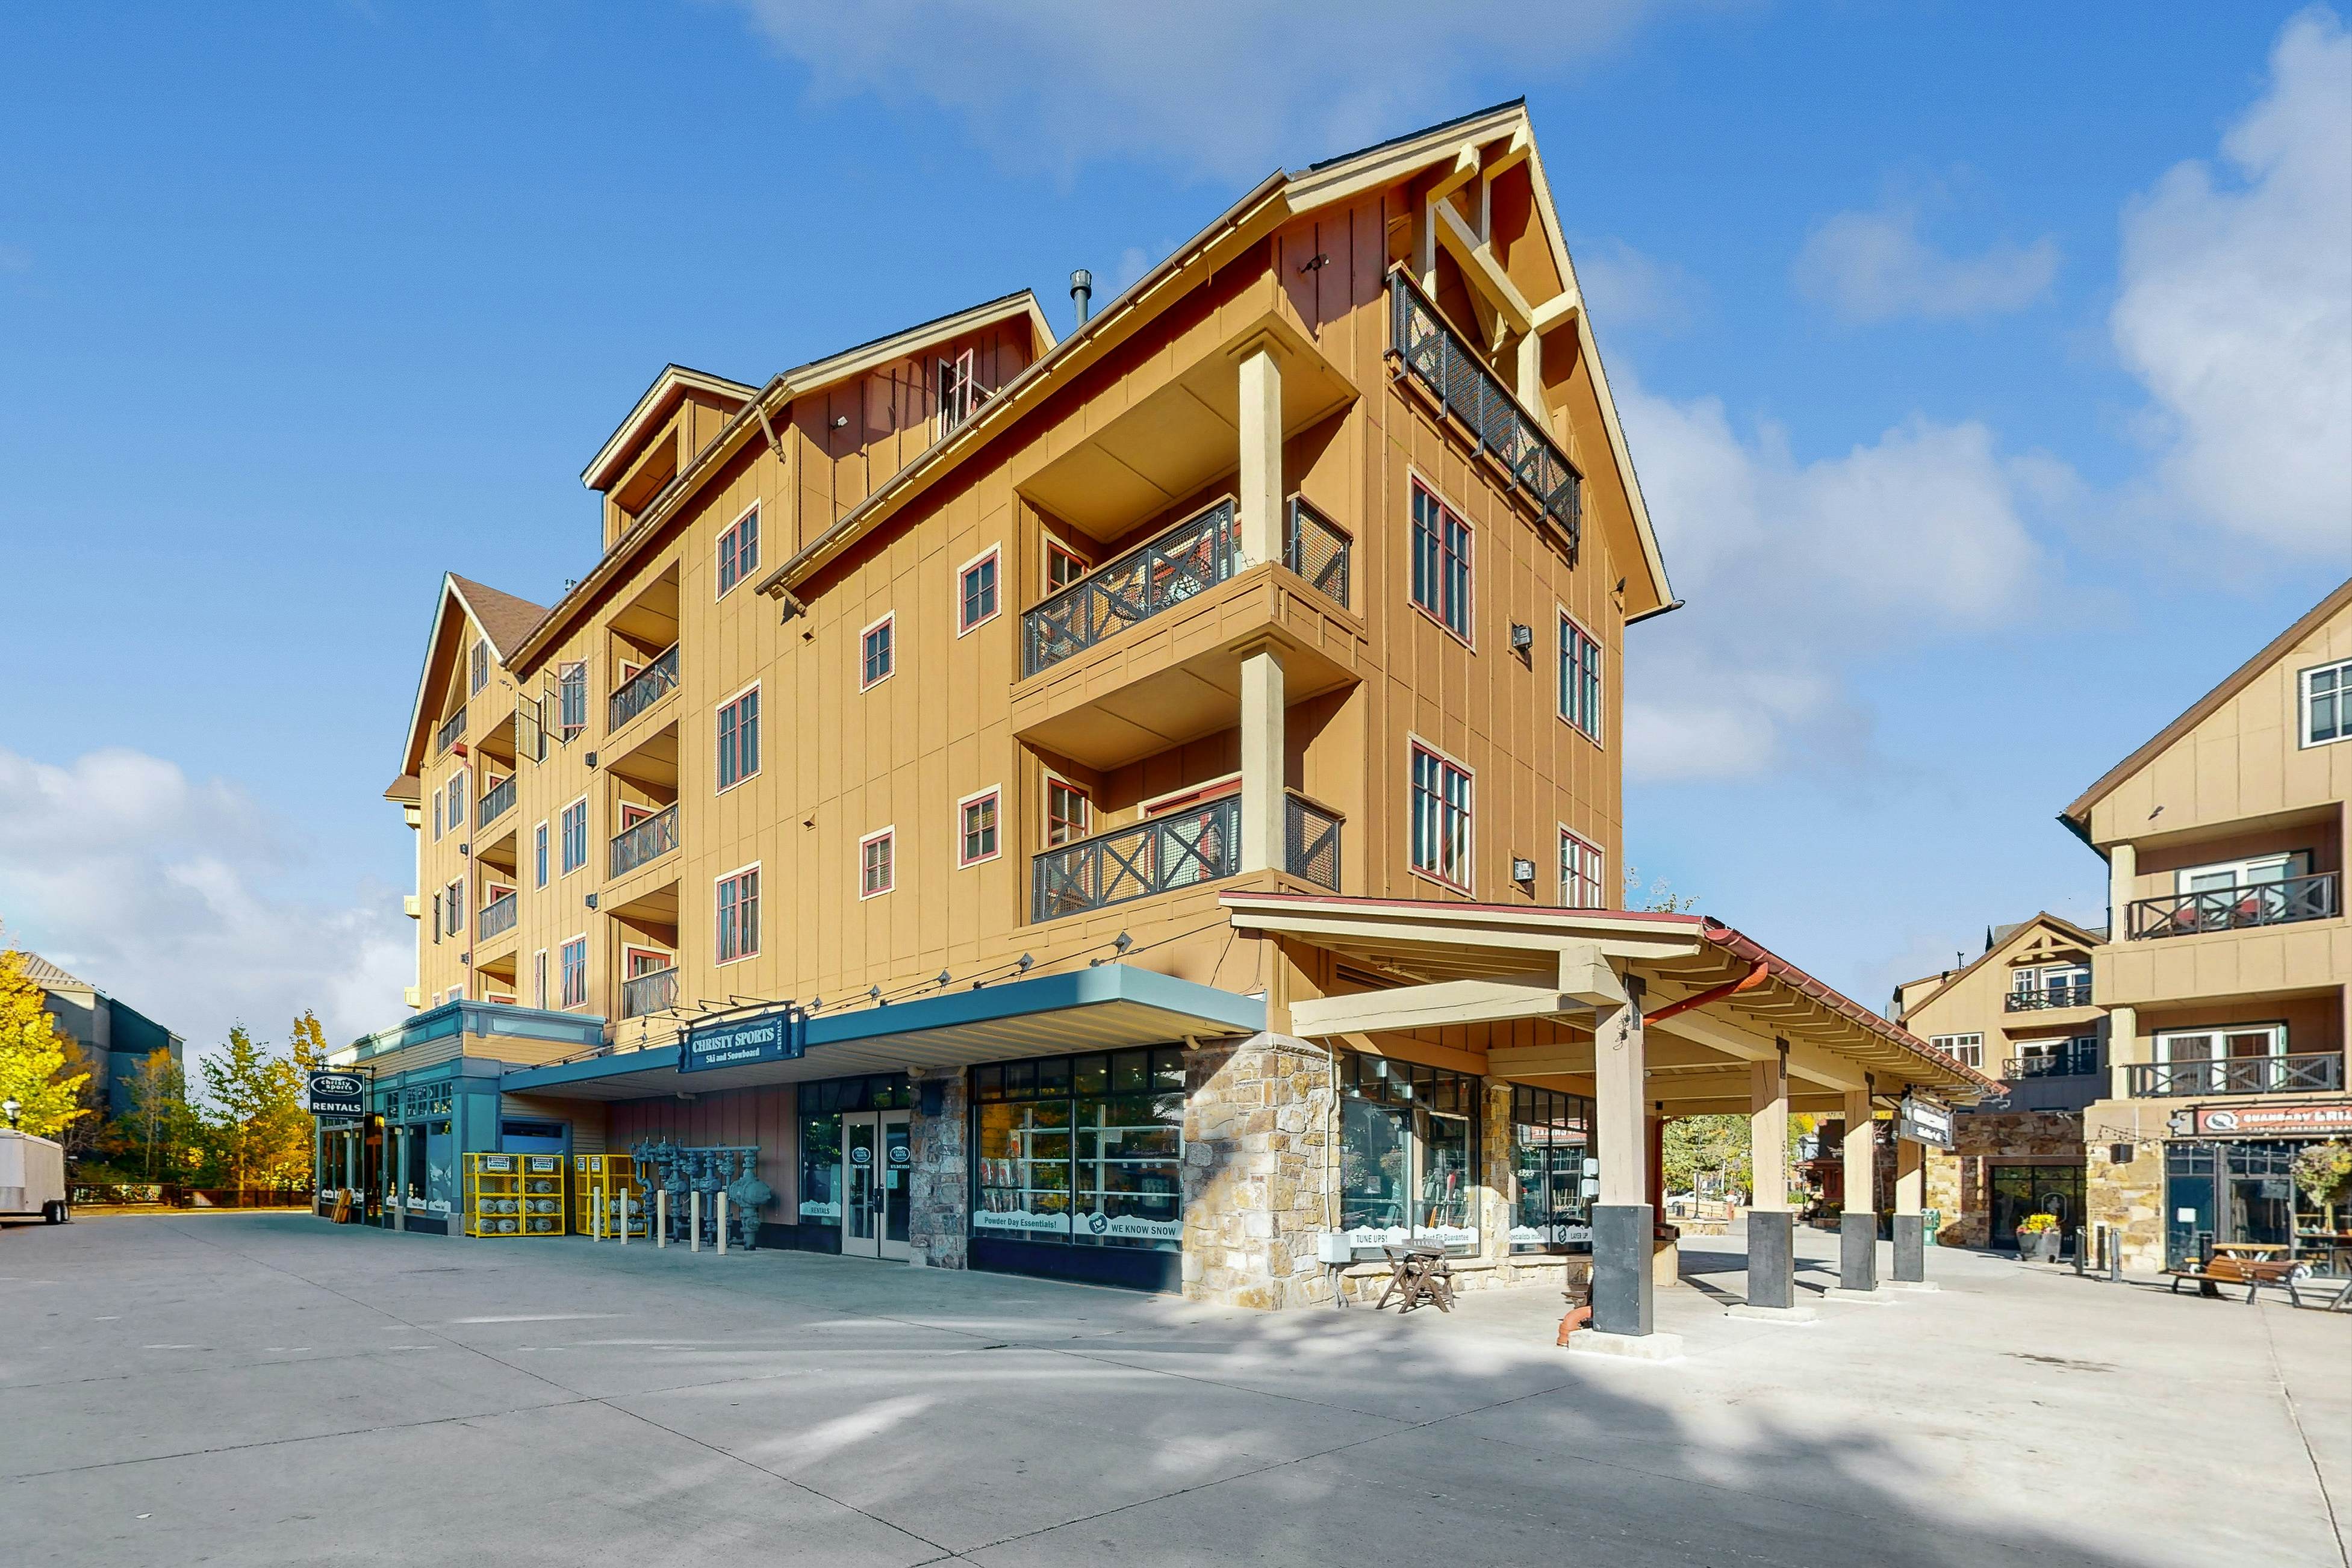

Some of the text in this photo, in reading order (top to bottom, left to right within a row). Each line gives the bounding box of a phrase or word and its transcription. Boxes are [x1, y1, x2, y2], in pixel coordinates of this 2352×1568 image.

[692, 1027, 774, 1053] CHRISTY SPORTS
[706, 1047, 760, 1063] Ski and Snowboard
[313, 1103, 361, 1112] RENTALS
[985, 1216, 1057, 1228] Powder Day Essentials!
[1112, 1224, 1176, 1235] WE KNOW SNOW
[1356, 1234, 1372, 1243] TUNE
